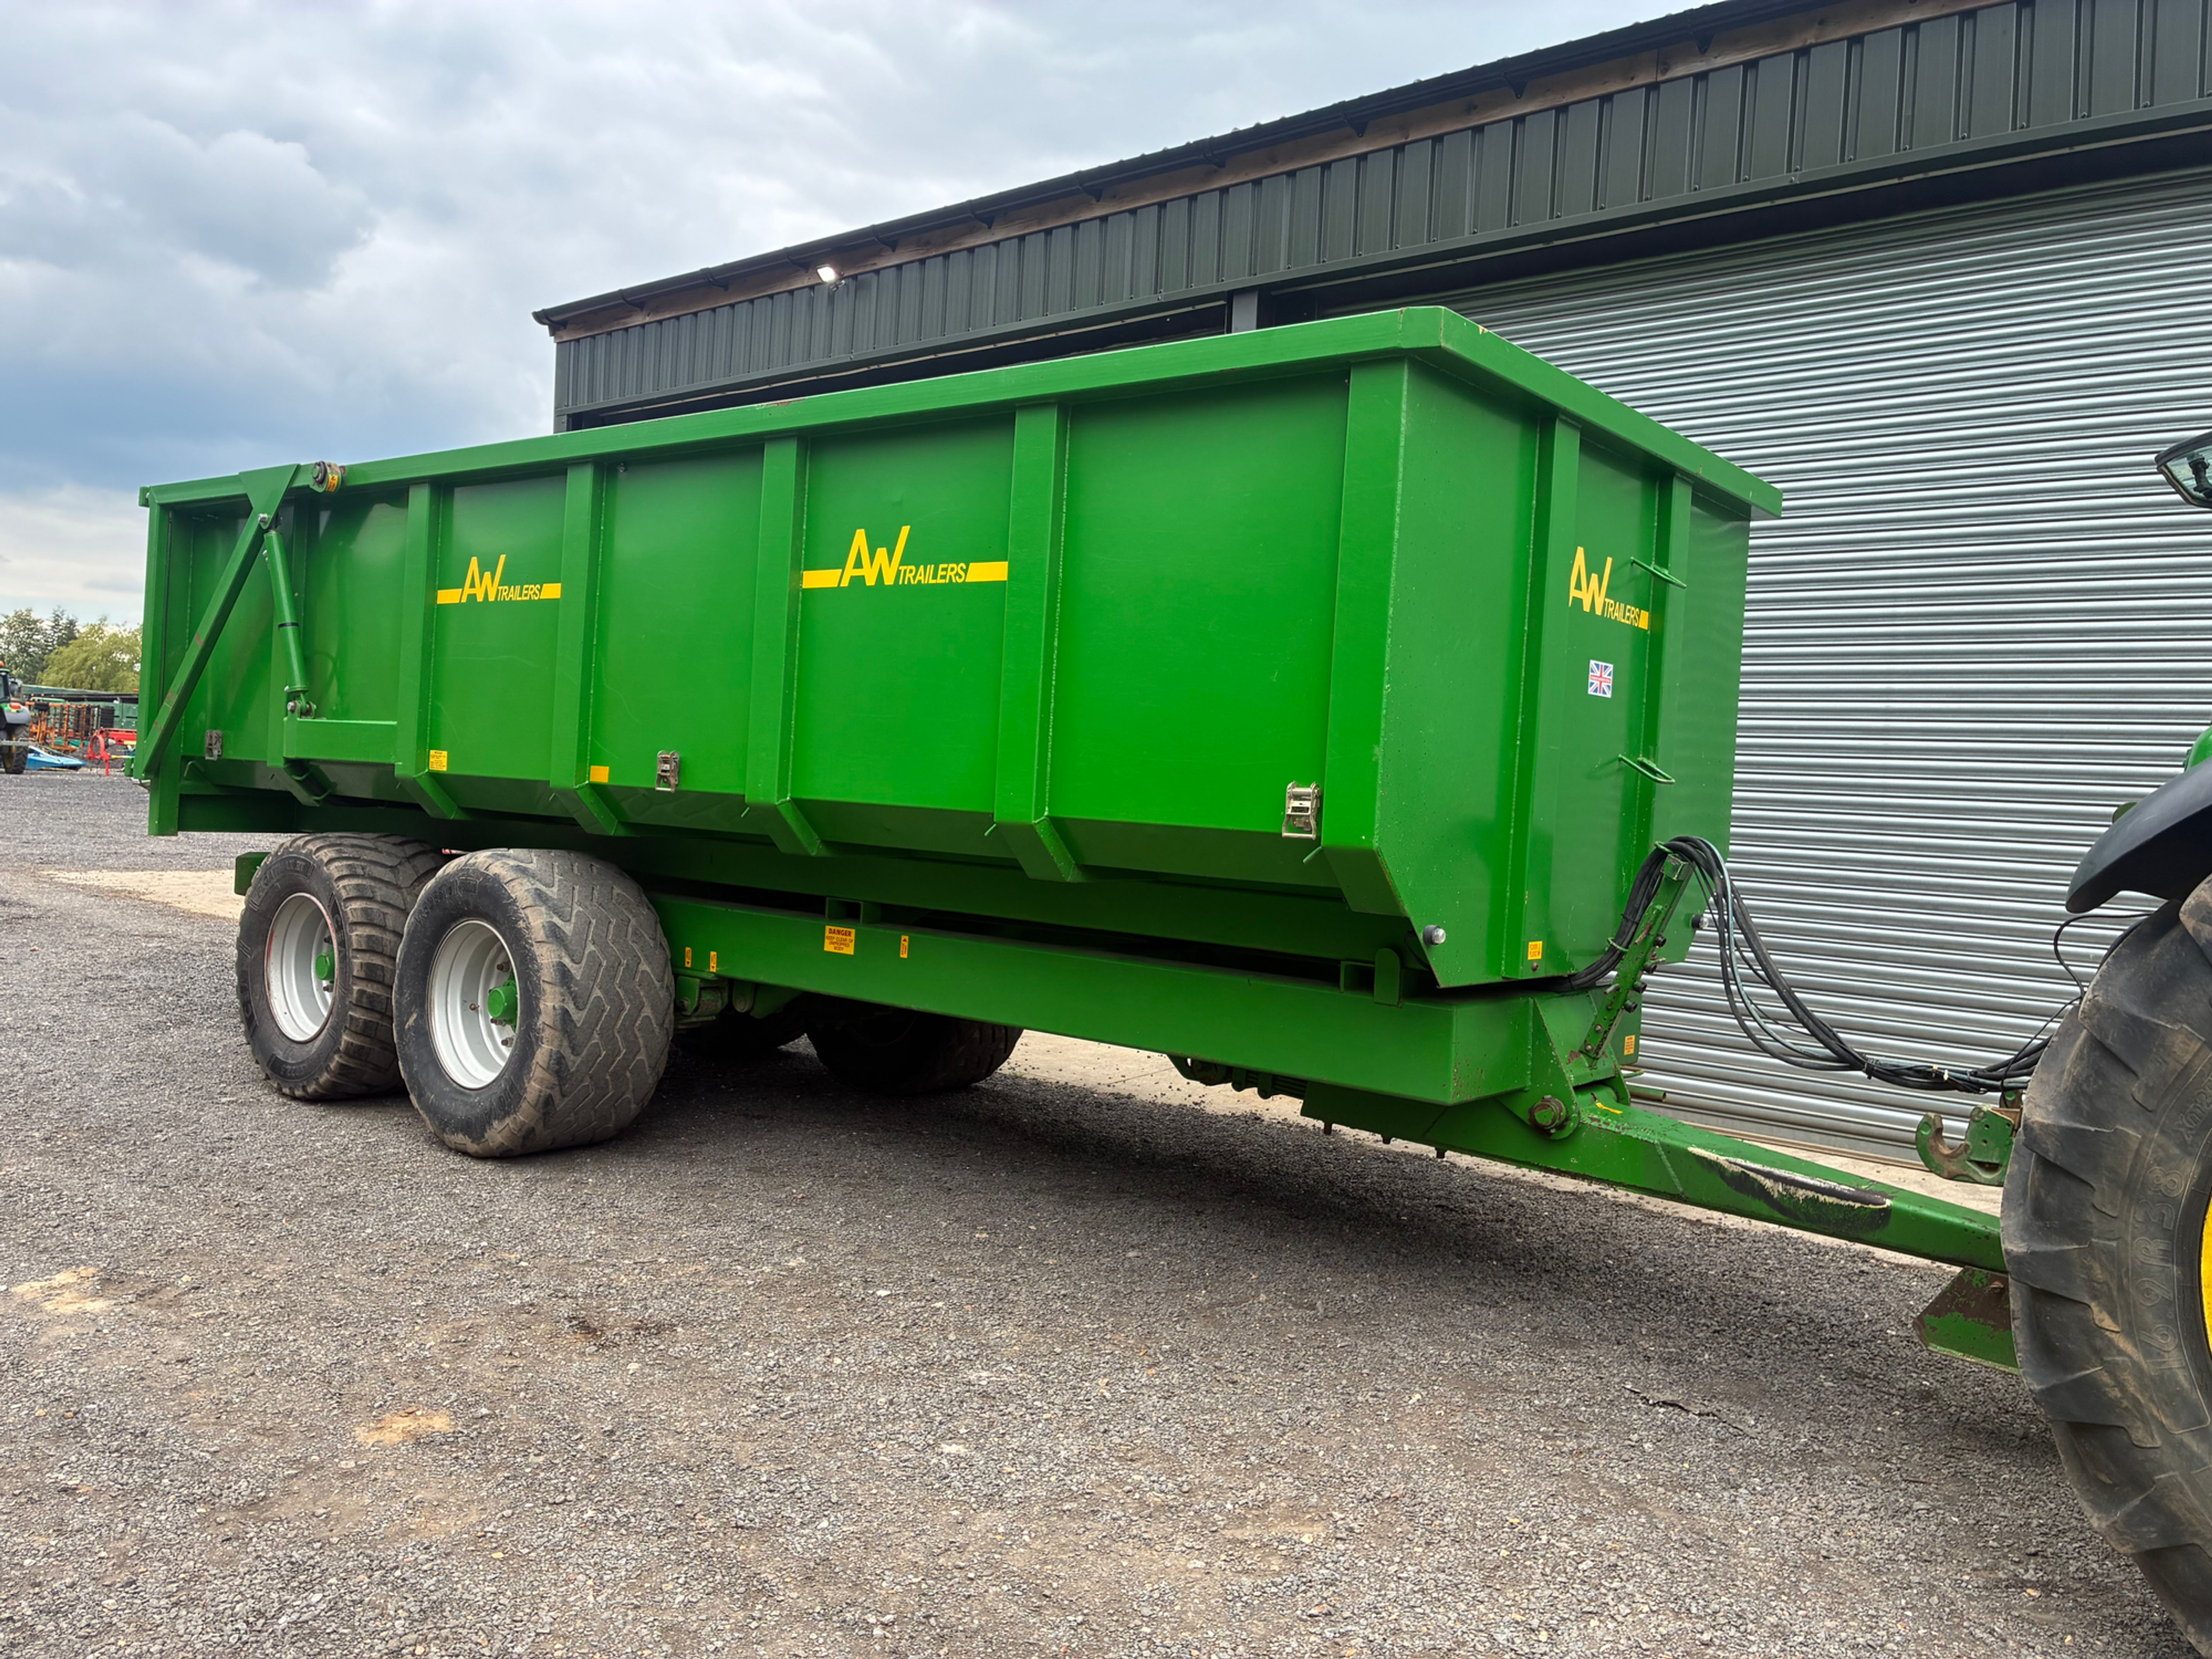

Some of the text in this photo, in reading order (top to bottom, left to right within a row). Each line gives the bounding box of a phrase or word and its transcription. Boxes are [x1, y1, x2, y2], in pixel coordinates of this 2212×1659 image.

[461, 554, 541, 603] AW TRAILERS
[840, 525, 967, 587] AW TRAILERS
[1568, 546, 1640, 627] AW TRAILERS
[829, 928, 852, 937] DANGER
